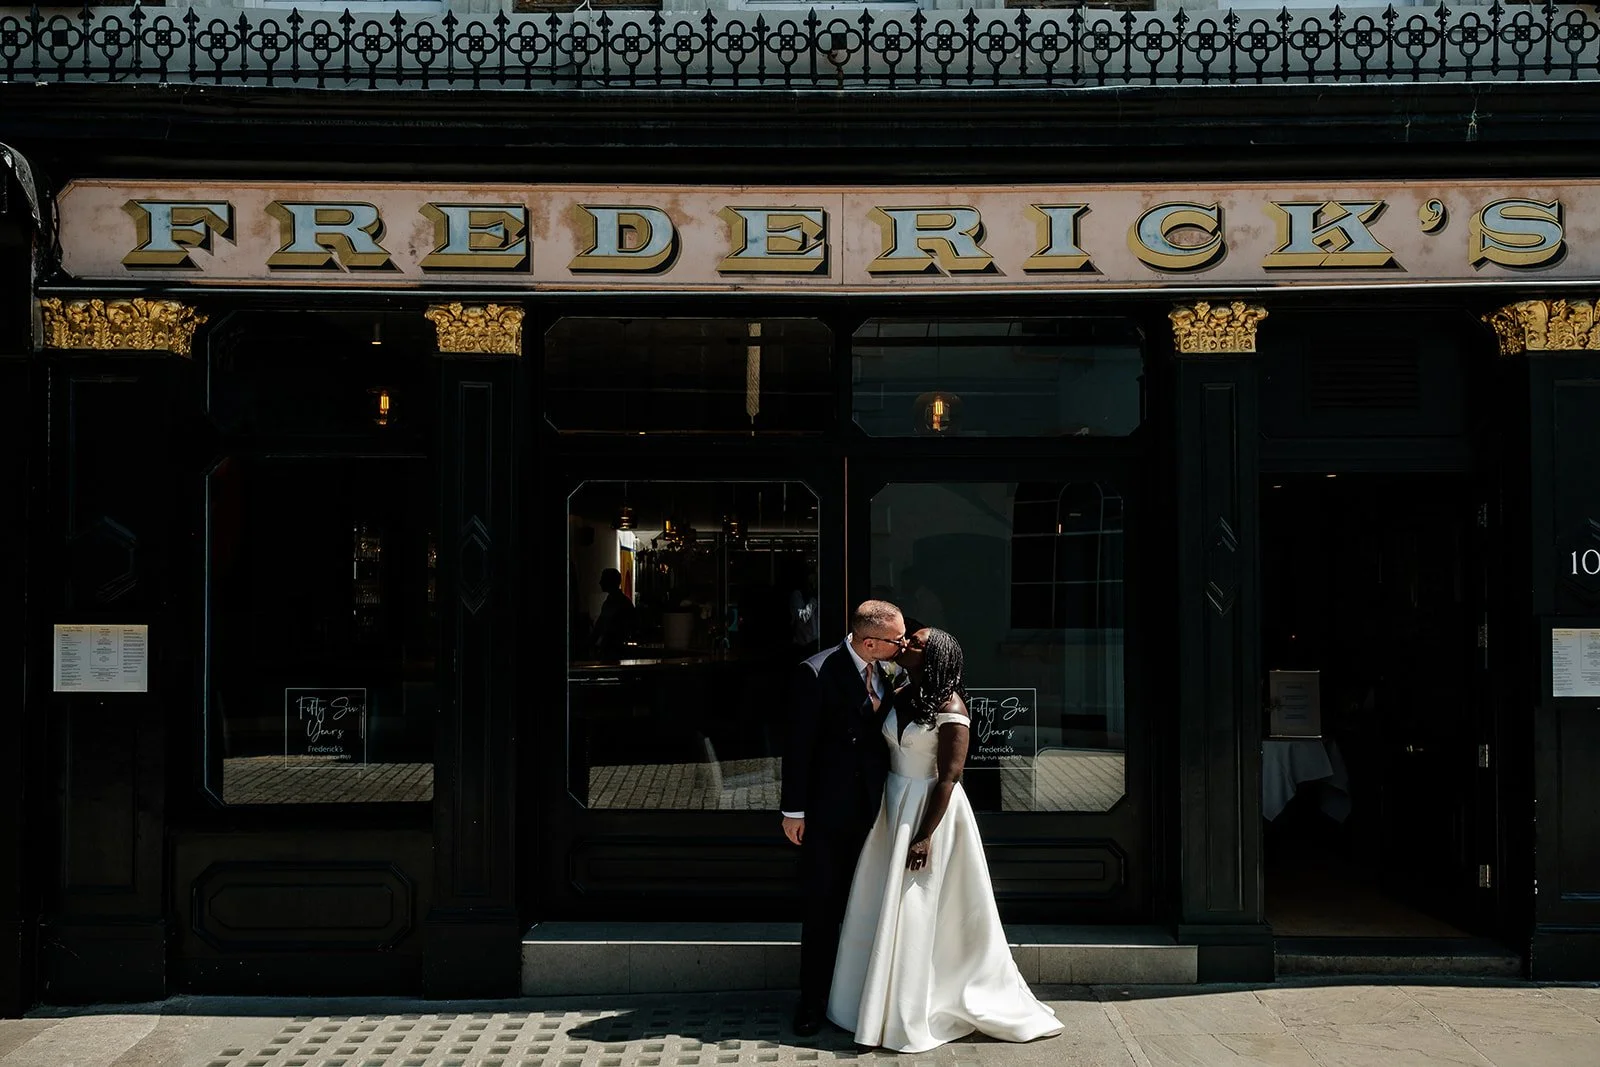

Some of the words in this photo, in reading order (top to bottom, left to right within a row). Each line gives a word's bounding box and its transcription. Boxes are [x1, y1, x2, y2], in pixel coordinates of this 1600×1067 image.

[120, 197, 1568, 273] FREDERICK'S
[296, 696, 326, 723] Fifty
[331, 697, 358, 720] Six
[966, 697, 998, 723] Fifty
[1001, 697, 1028, 720] Six
[307, 720, 344, 742] Years
[978, 720, 1014, 743] Years
[308, 745, 343, 753] Frederick's
[978, 745, 1014, 753] Frederick's
